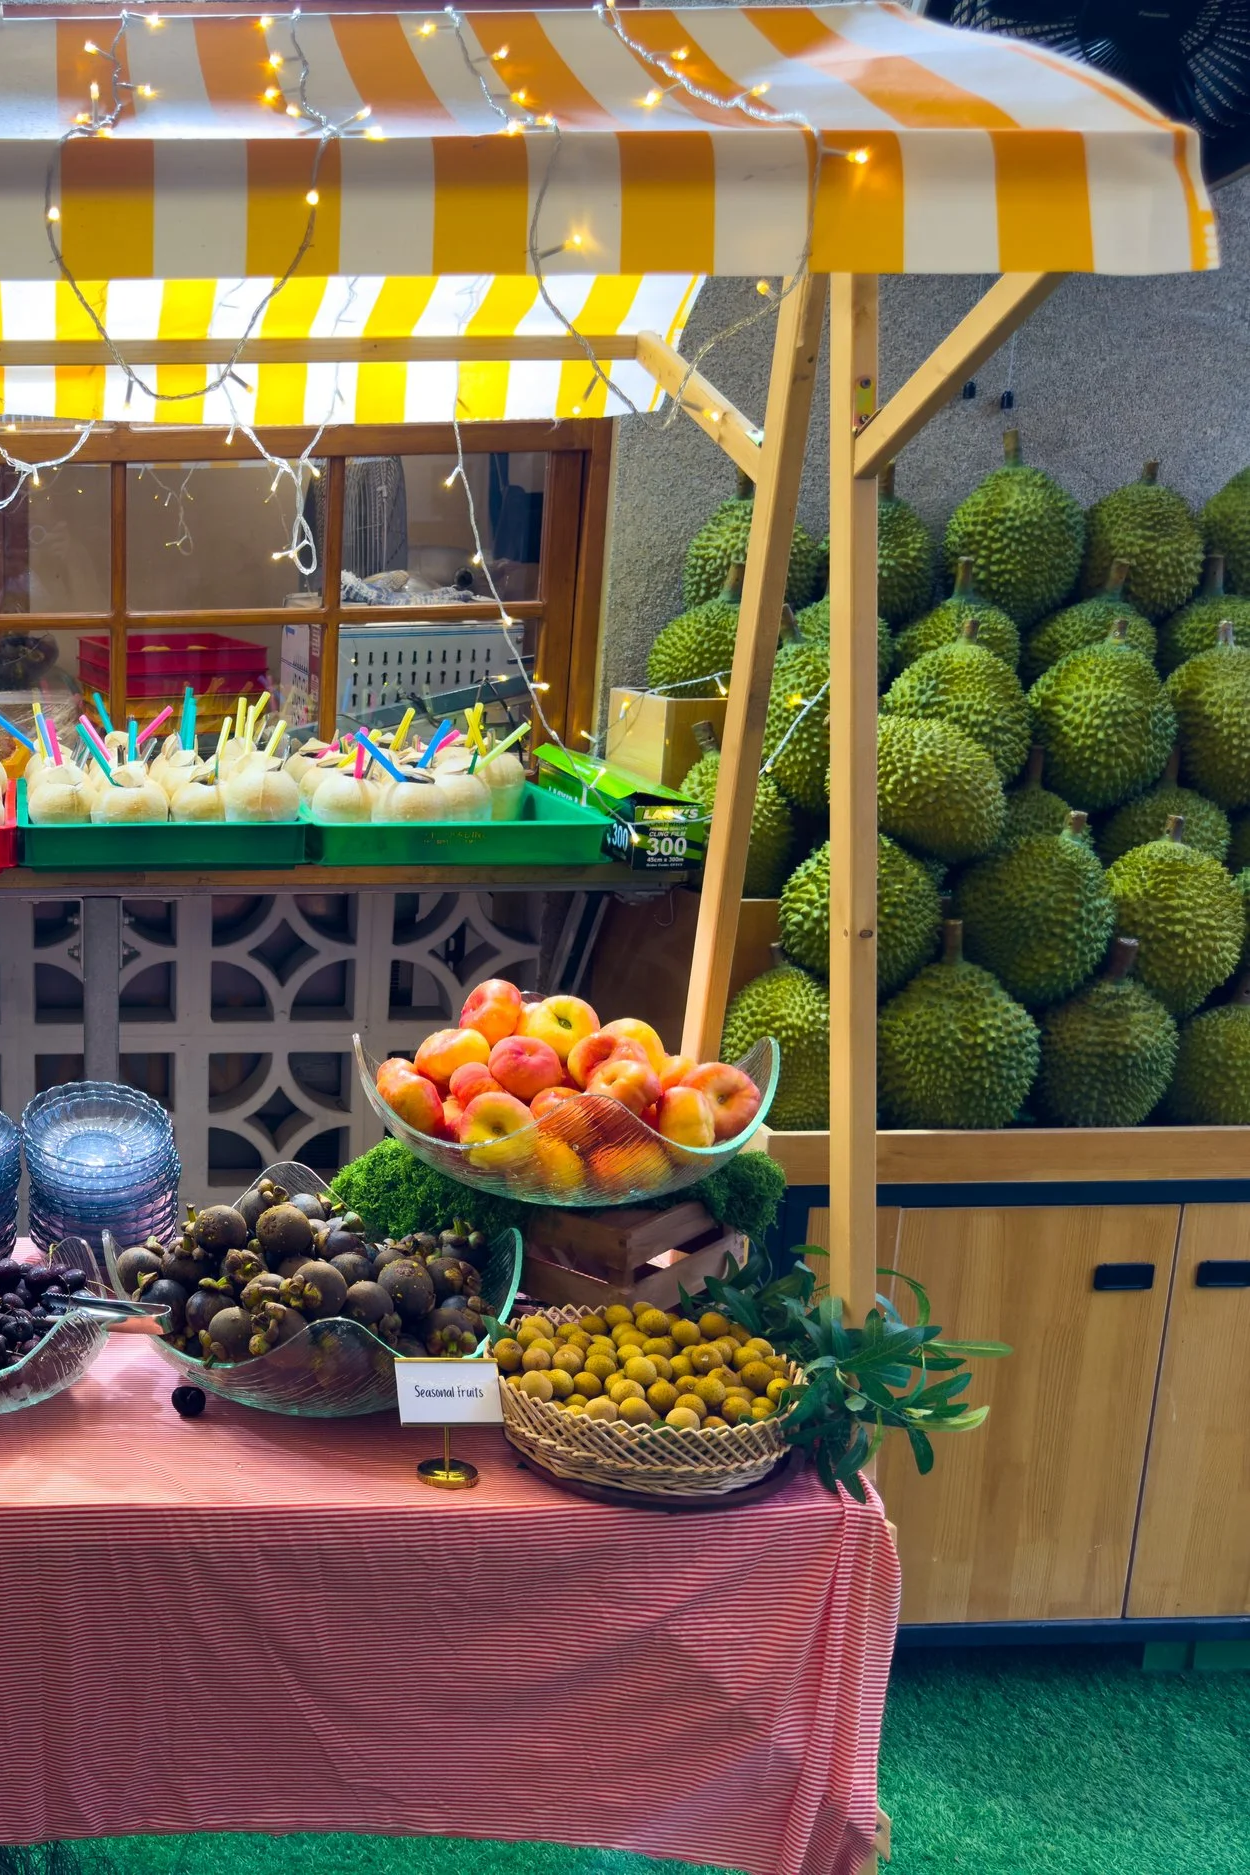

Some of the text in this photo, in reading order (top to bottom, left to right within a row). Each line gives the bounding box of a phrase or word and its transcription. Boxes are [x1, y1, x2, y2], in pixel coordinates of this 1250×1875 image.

[612, 823, 629, 852] 300
[646, 837, 688, 856] 300
[414, 1384, 484, 1398] Seasonal Fruits
